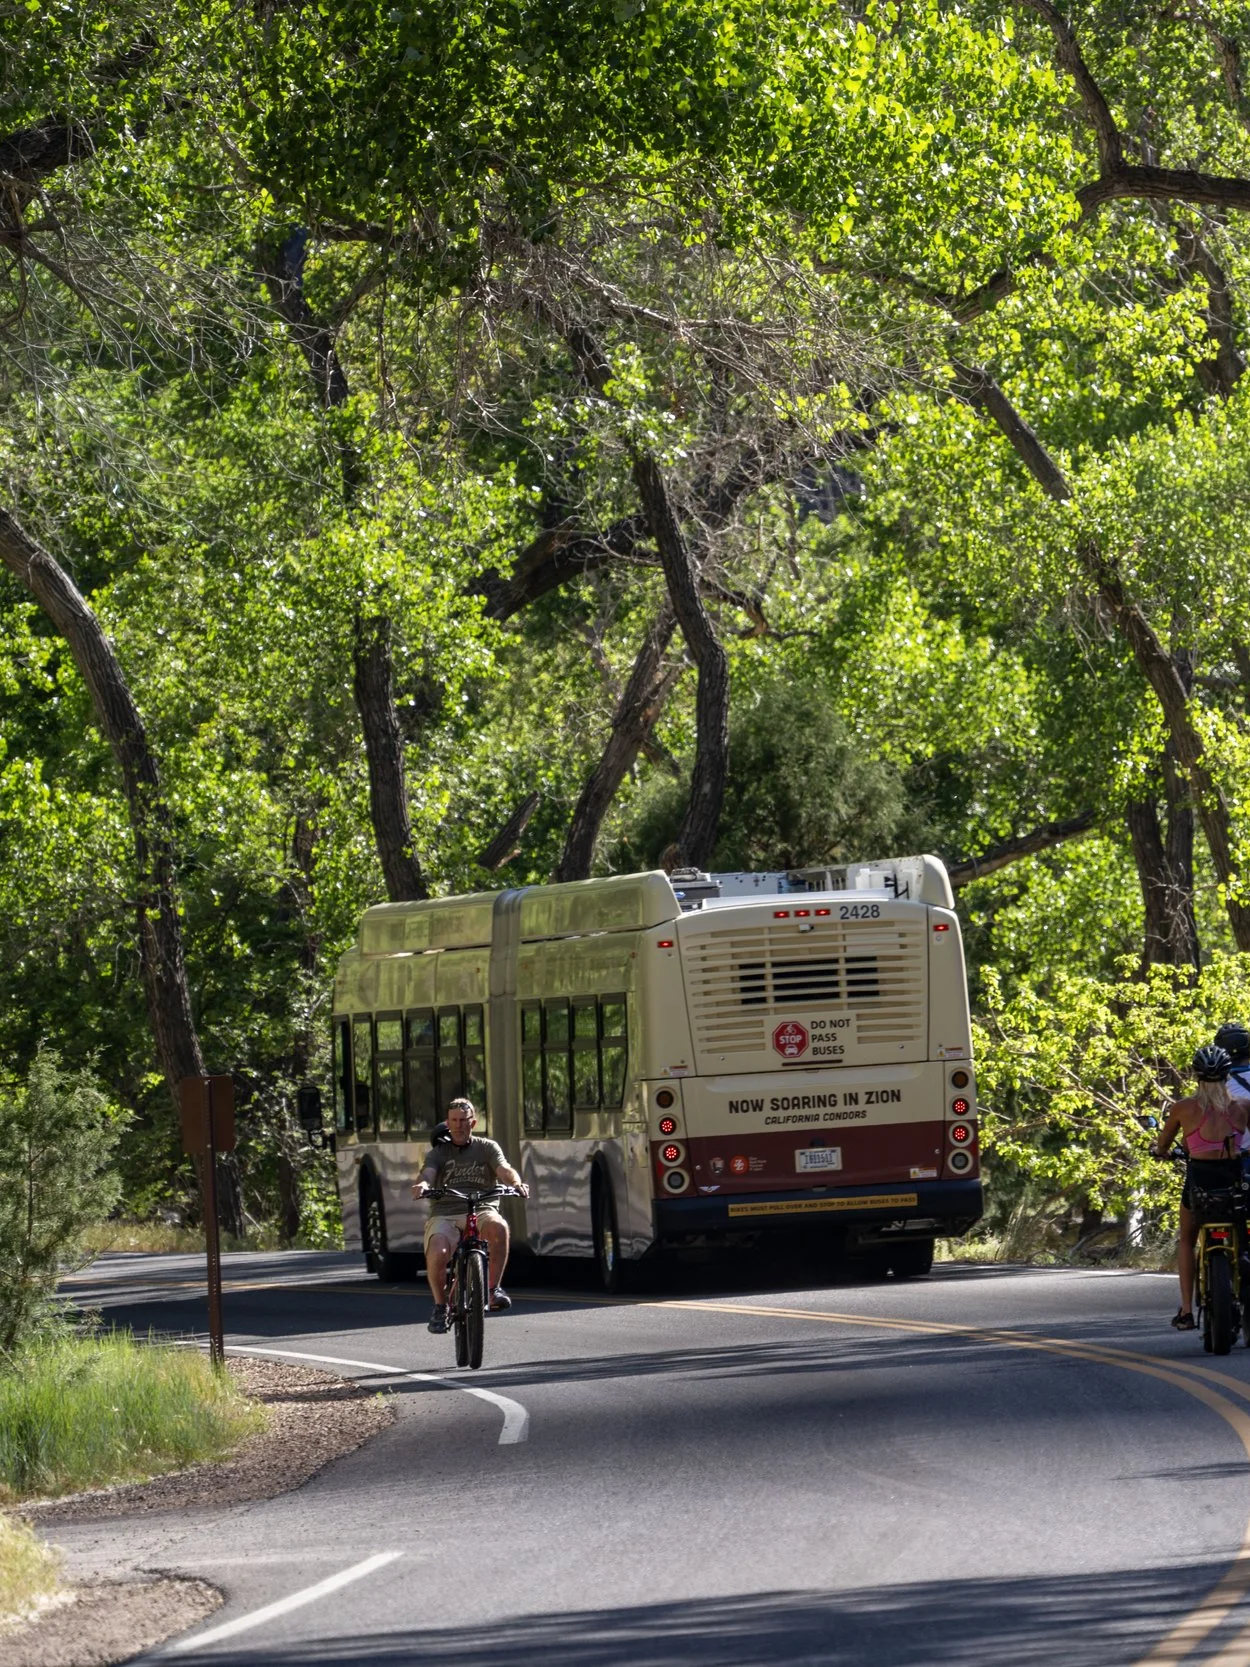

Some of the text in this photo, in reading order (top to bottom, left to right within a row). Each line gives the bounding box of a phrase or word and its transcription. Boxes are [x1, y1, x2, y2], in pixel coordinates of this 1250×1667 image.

[840, 904, 880, 920] 2428
[810, 1018, 851, 1030] DO NOT
[779, 1034, 803, 1044] STOP
[811, 1032, 837, 1043] PASS
[812, 1045, 845, 1056] BUSES
[728, 1089, 902, 1114] NOW SOARING IN ZION
[764, 1110, 868, 1126] CALIFORNIA CONDORS
